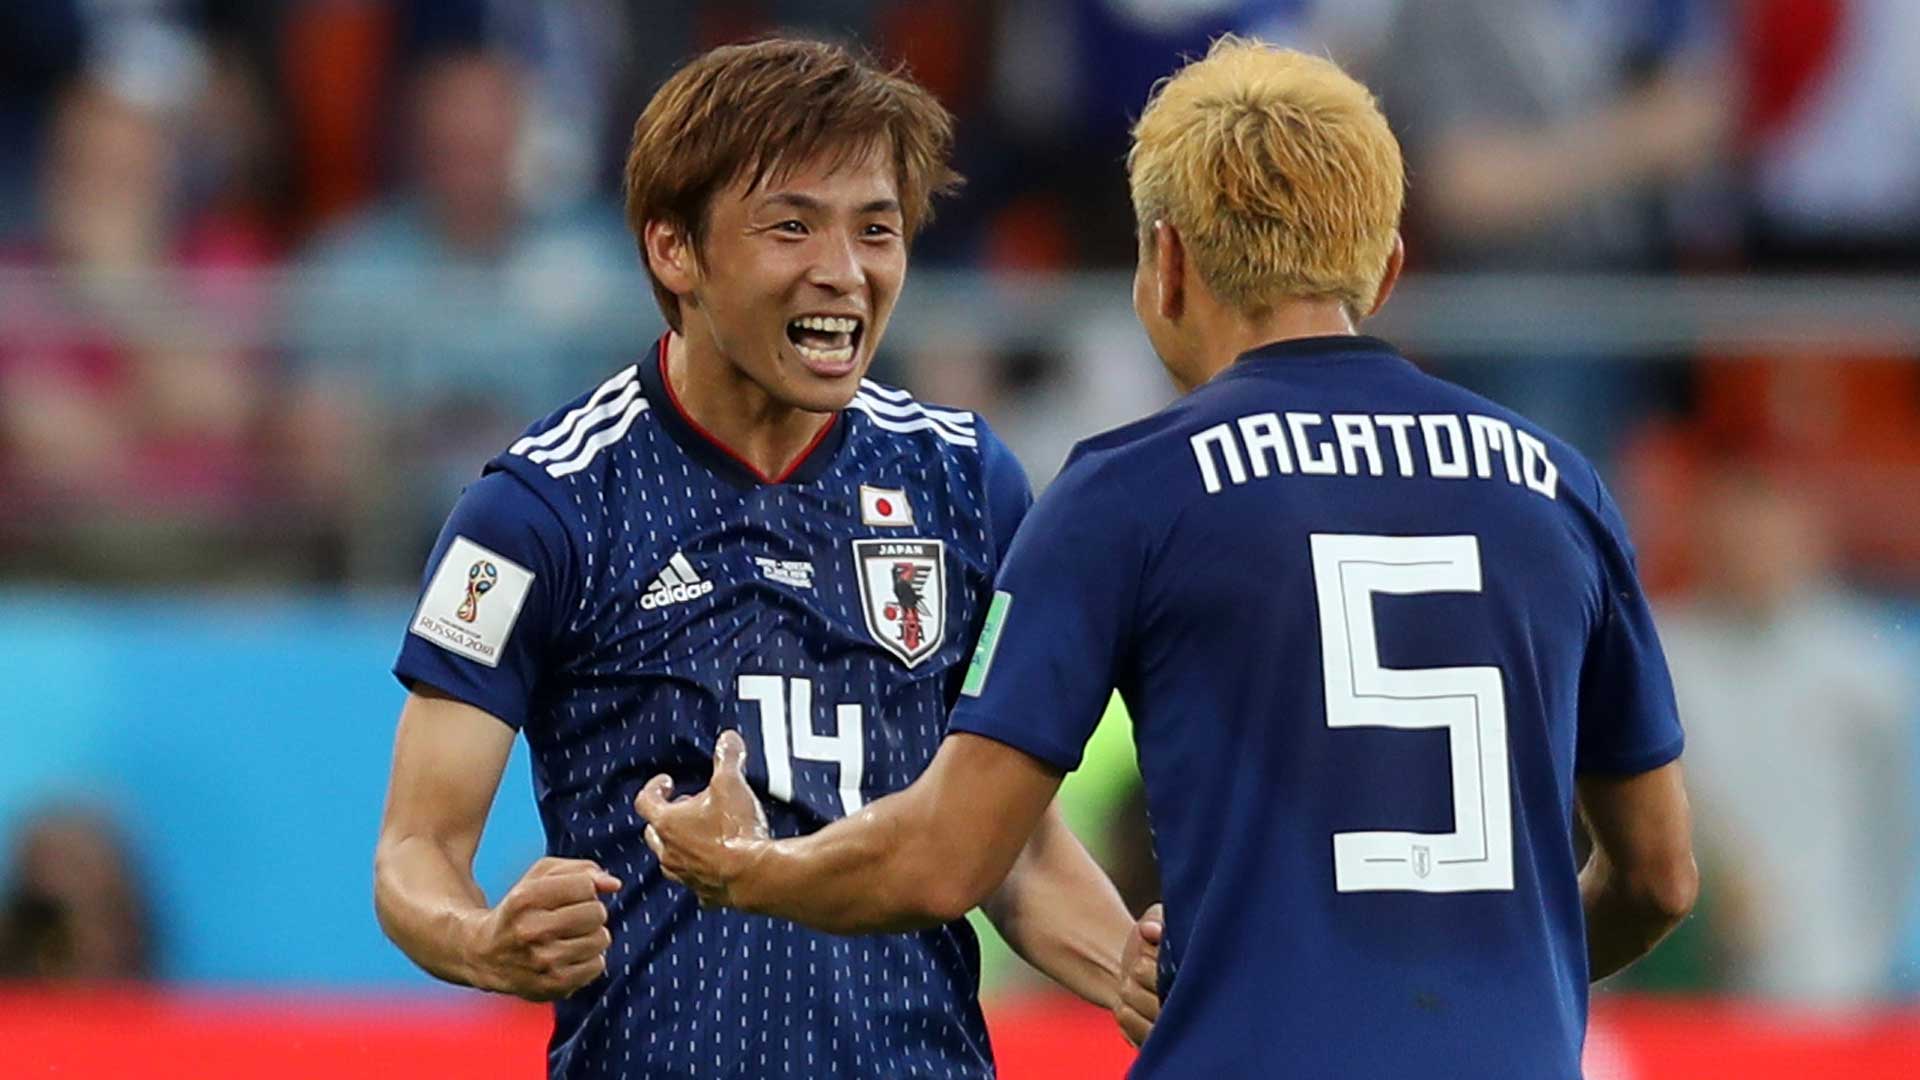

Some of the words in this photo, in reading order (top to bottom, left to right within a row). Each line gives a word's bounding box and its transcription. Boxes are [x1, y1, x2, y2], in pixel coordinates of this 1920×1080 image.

[1191, 413, 1559, 500] NAGATOMO
[878, 545, 924, 556] JAPAN
[640, 580, 714, 610] adidas
[420, 616, 463, 644] RUSSIA
[1310, 534, 1514, 892] 5
[738, 675, 863, 816] 14
